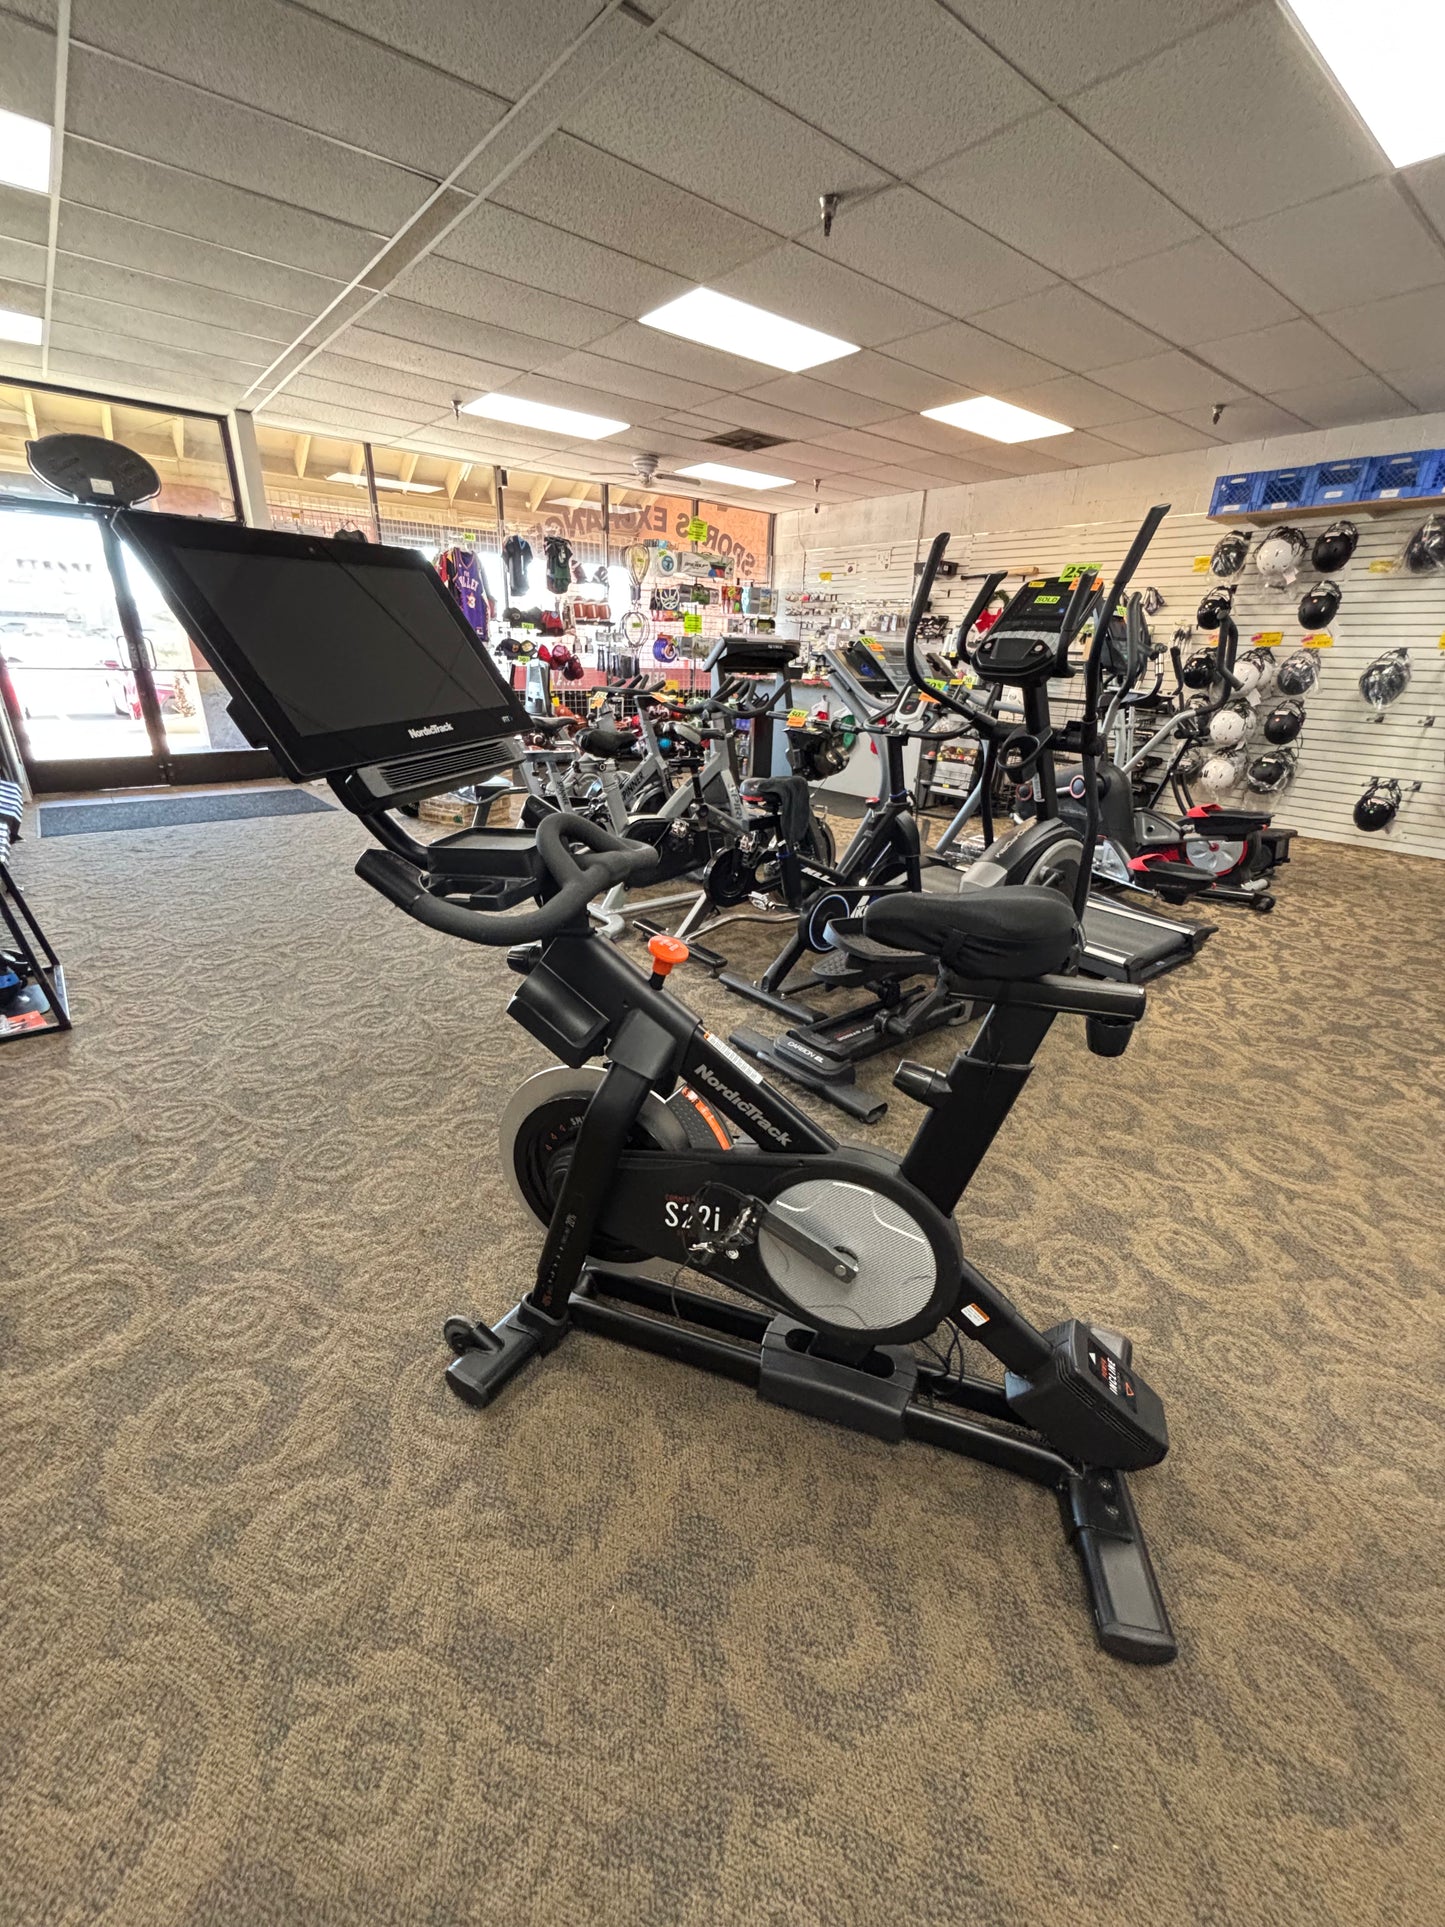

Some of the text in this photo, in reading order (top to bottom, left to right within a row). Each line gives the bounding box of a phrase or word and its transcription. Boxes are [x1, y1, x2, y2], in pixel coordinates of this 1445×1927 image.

[1036, 595, 1059, 603] SOLD
[408, 722, 454, 739] NordicTrack
[621, 771, 644, 801] PINNER
[787, 1041, 815, 1059] CARBON
[694, 1063, 793, 1147] NordicTrack
[1107, 1356, 1118, 1396] INCLINE
